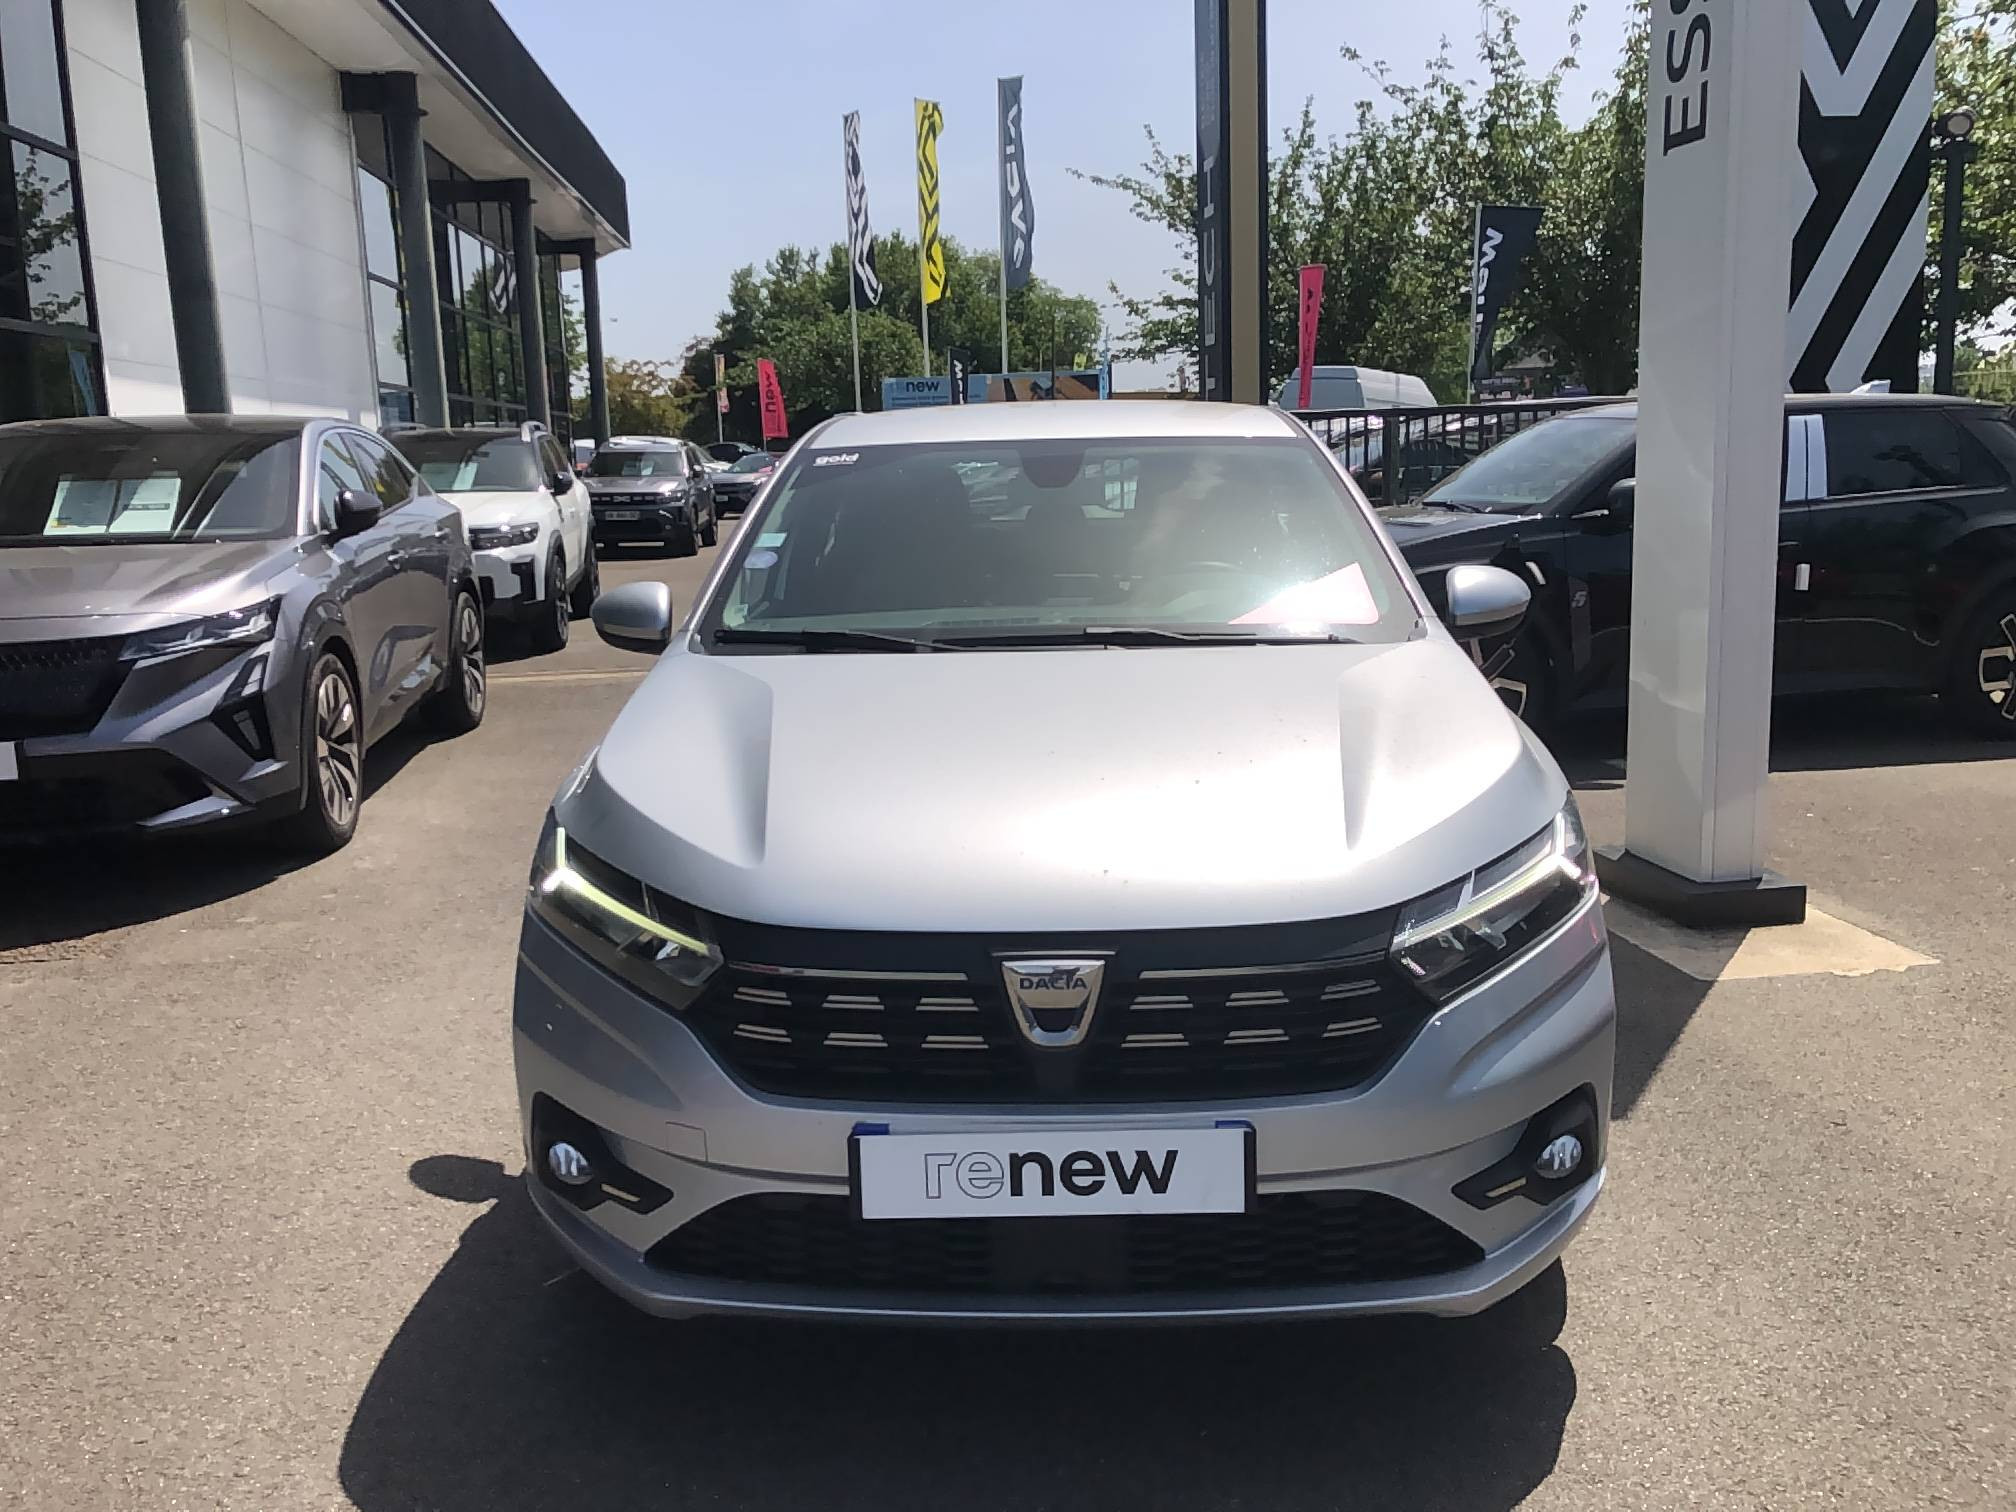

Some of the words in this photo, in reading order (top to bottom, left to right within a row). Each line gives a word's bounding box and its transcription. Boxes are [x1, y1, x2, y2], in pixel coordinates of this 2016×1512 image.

[1663, 0, 1712, 157] ES
[1006, 103, 1028, 269] DACIA
[905, 380, 940, 393] new
[813, 452, 861, 466] gold
[1019, 976, 1088, 990] DACIA
[924, 1149, 1180, 1199] renew
